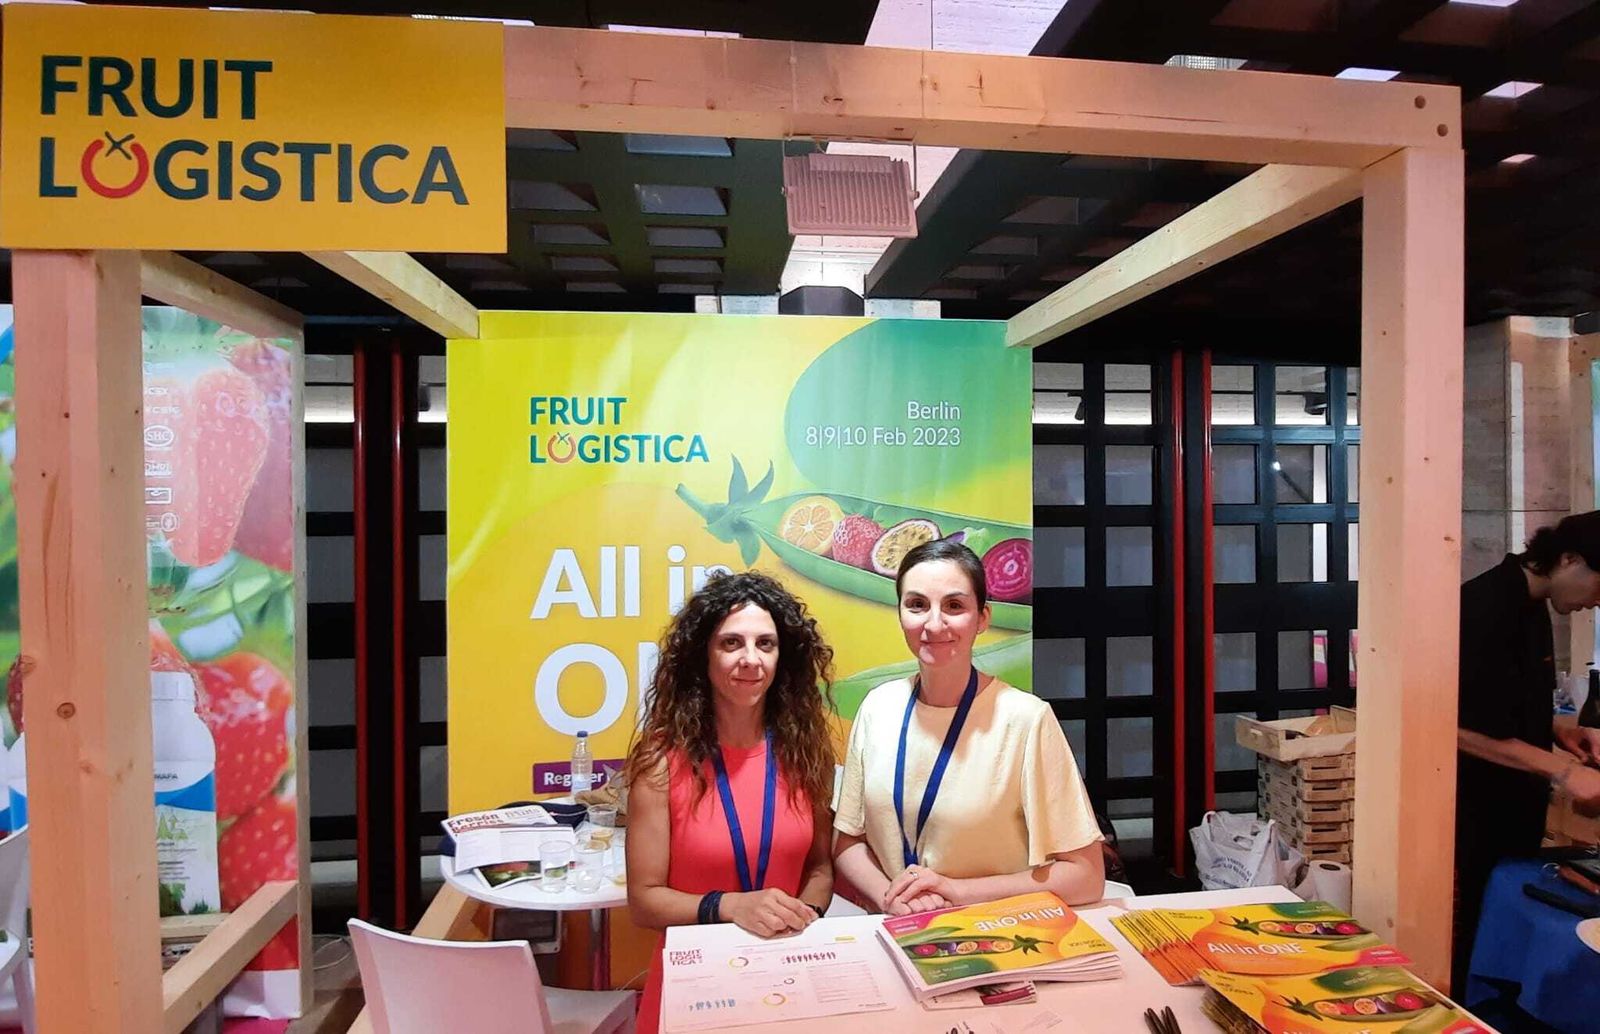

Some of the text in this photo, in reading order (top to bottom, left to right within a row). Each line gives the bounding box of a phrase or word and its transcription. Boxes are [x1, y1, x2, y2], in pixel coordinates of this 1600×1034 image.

[40, 55, 273, 120] FRUIT
[39, 132, 470, 206] LOGISTICA
[530, 396, 627, 425] FRUIT
[907, 401, 961, 420] Berlin
[530, 432, 709, 464] LOGISTICA
[873, 427, 906, 446] Feb
[912, 427, 961, 446] 2023
[530, 545, 640, 619] All
[974, 916, 1019, 931] ONE
[1040, 906, 1065, 919] All
[1207, 942, 1307, 955] All in ONE
